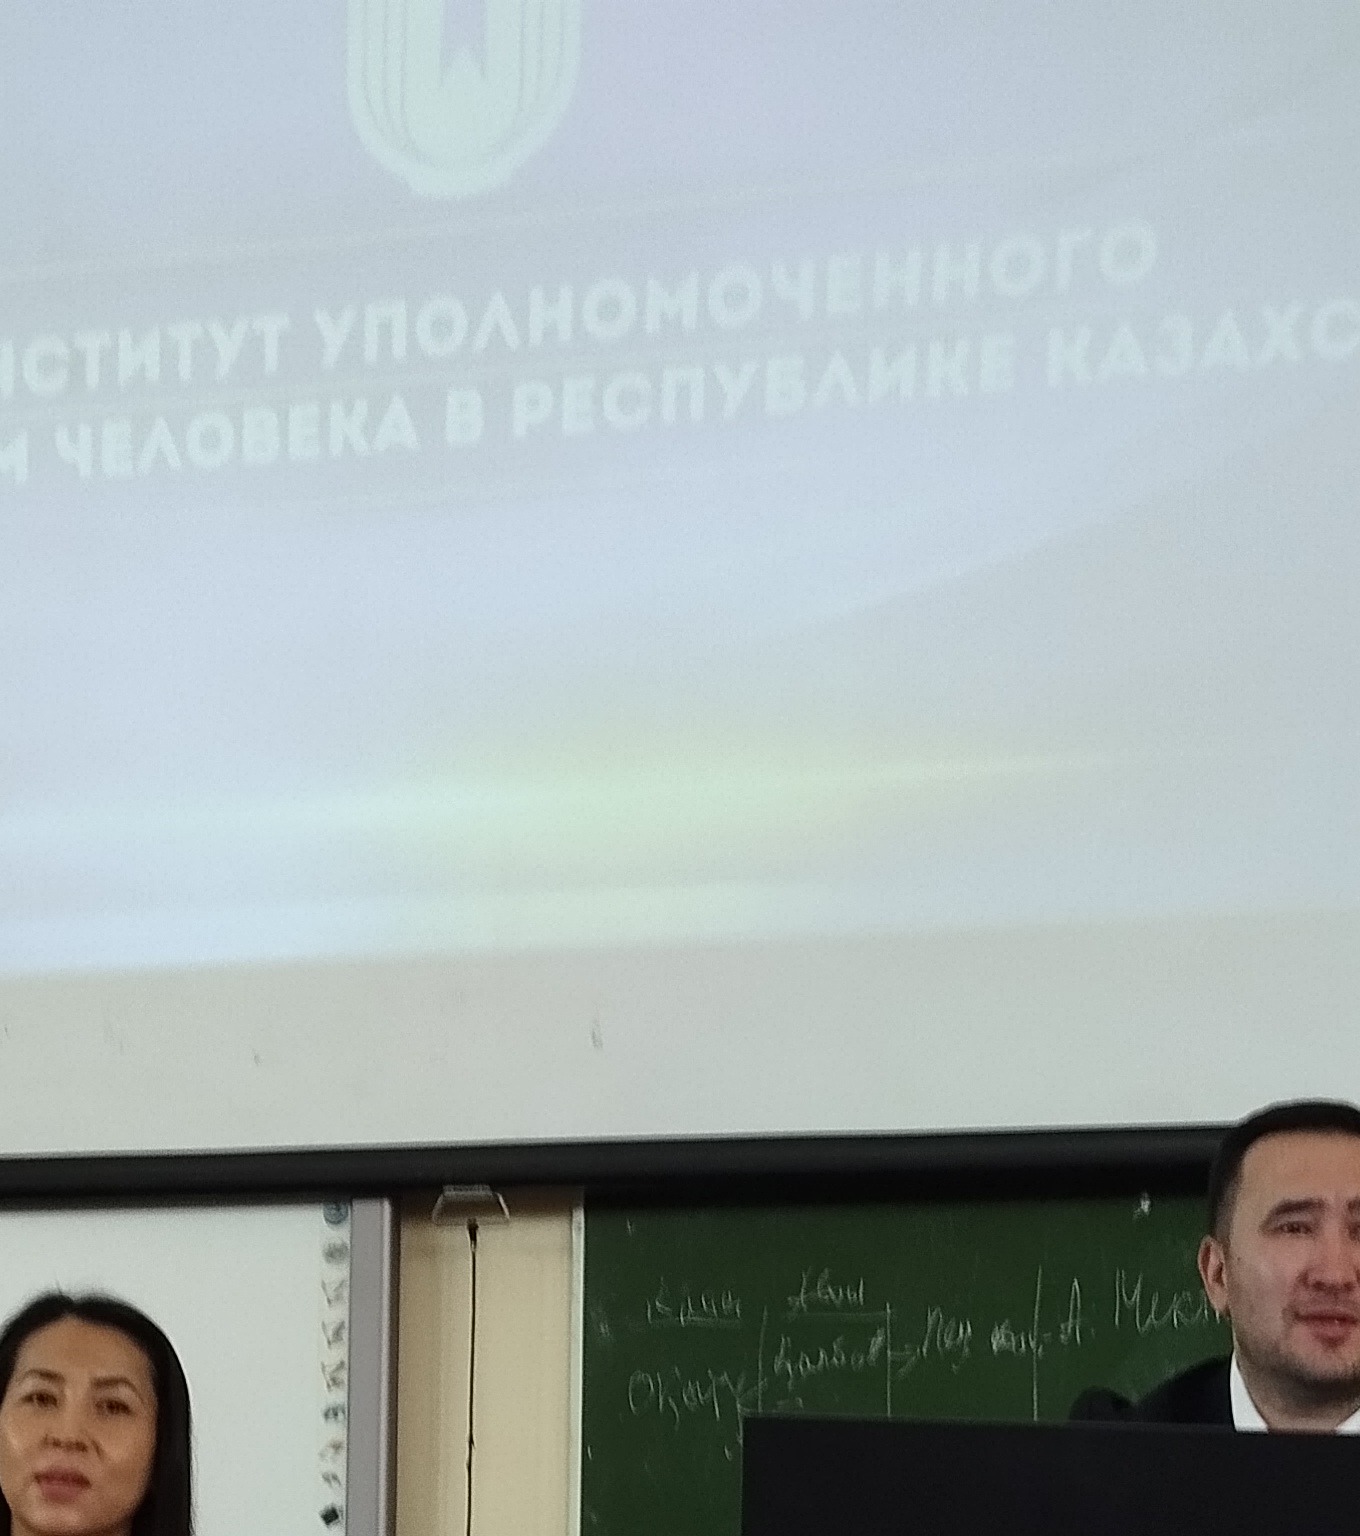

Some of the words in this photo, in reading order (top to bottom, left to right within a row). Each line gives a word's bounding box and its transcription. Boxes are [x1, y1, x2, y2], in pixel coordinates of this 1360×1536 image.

[313, 219, 1158, 368] УПОЛНОМОЧЕННОГО
[56, 395, 421, 480] ЧЕЛОВЕКА
[445, 387, 484, 445] В
[512, 331, 1017, 440] РЕСПУБЛИКЕ
